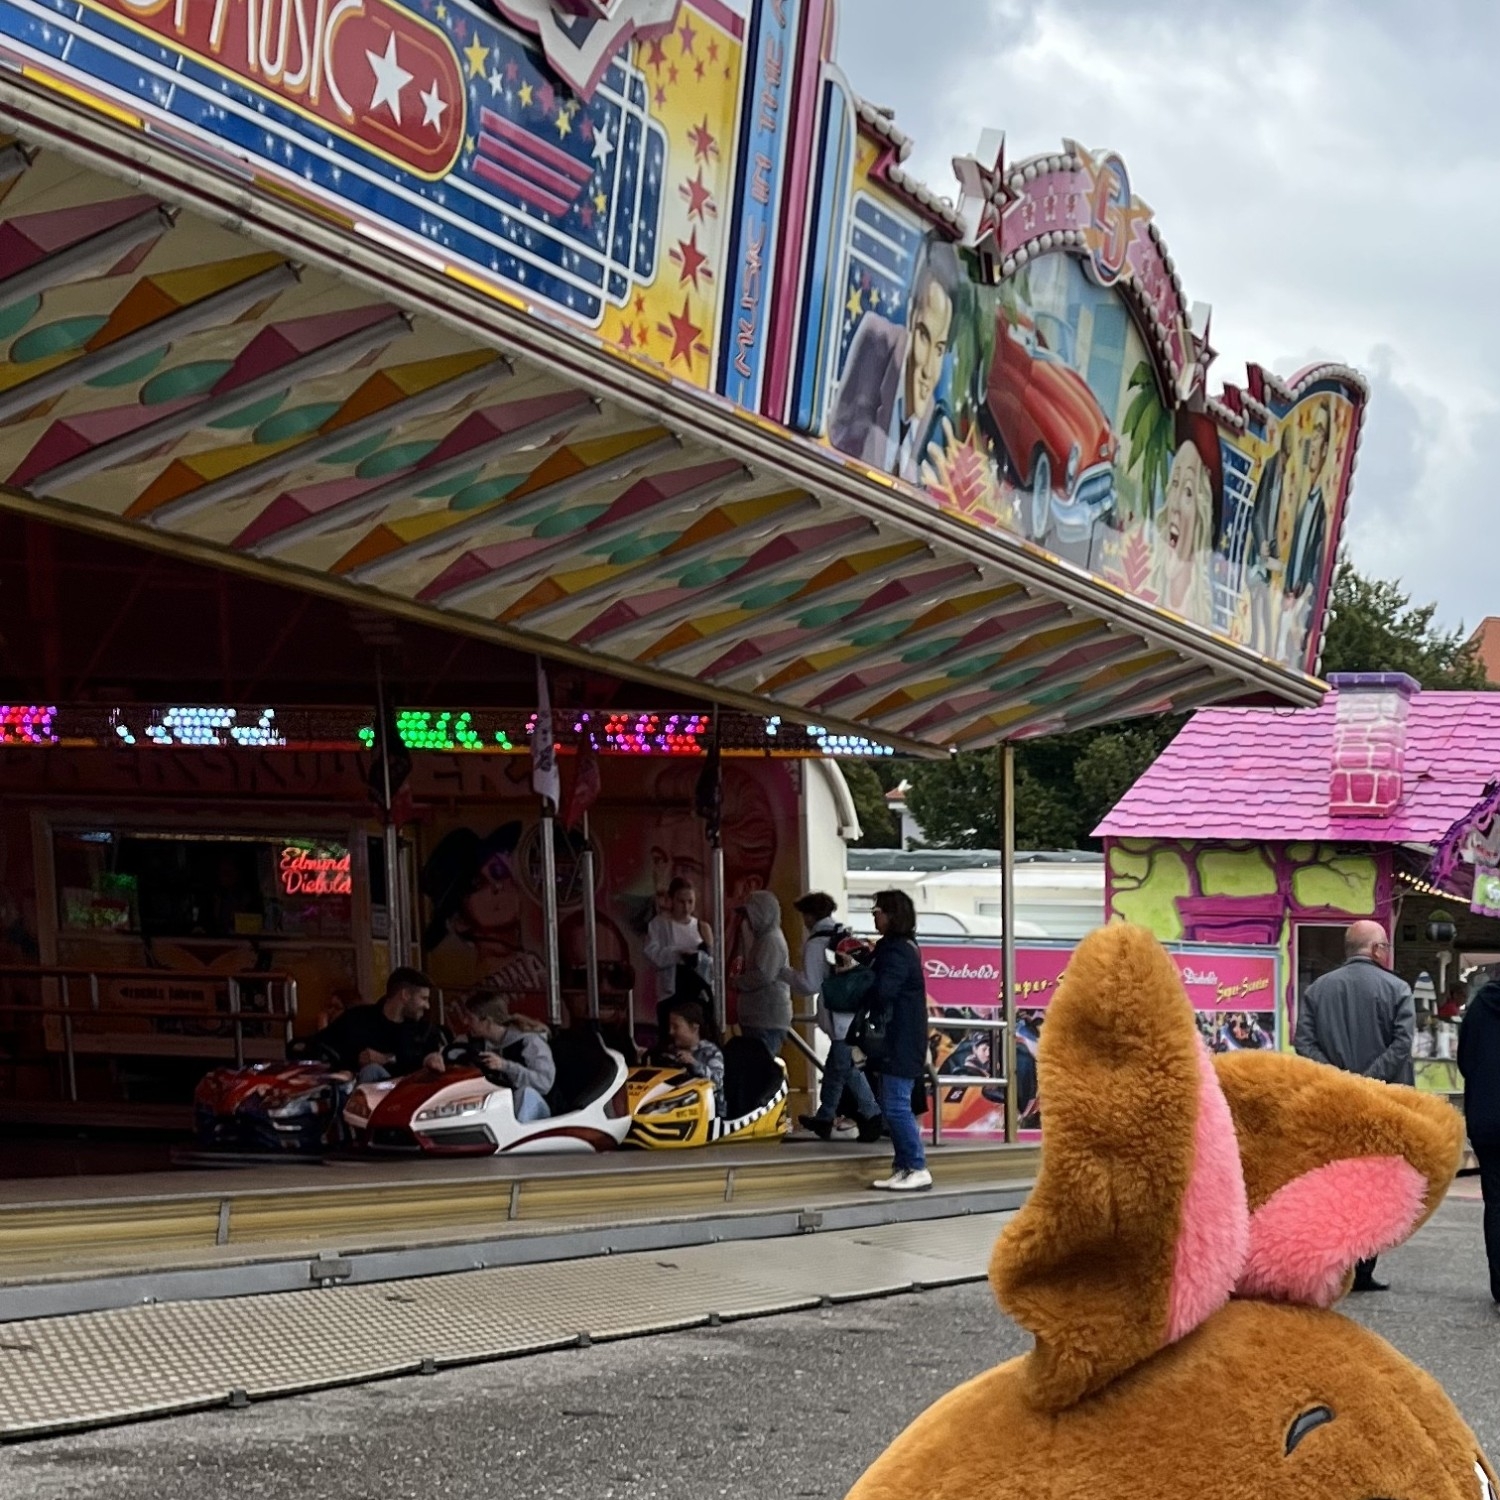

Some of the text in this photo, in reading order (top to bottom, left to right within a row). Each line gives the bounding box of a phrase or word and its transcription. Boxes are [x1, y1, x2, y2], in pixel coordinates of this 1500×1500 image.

[280, 847, 351, 872] Edmund
[281, 869, 351, 895] Diebold
[924, 959, 999, 979] Diebolds
